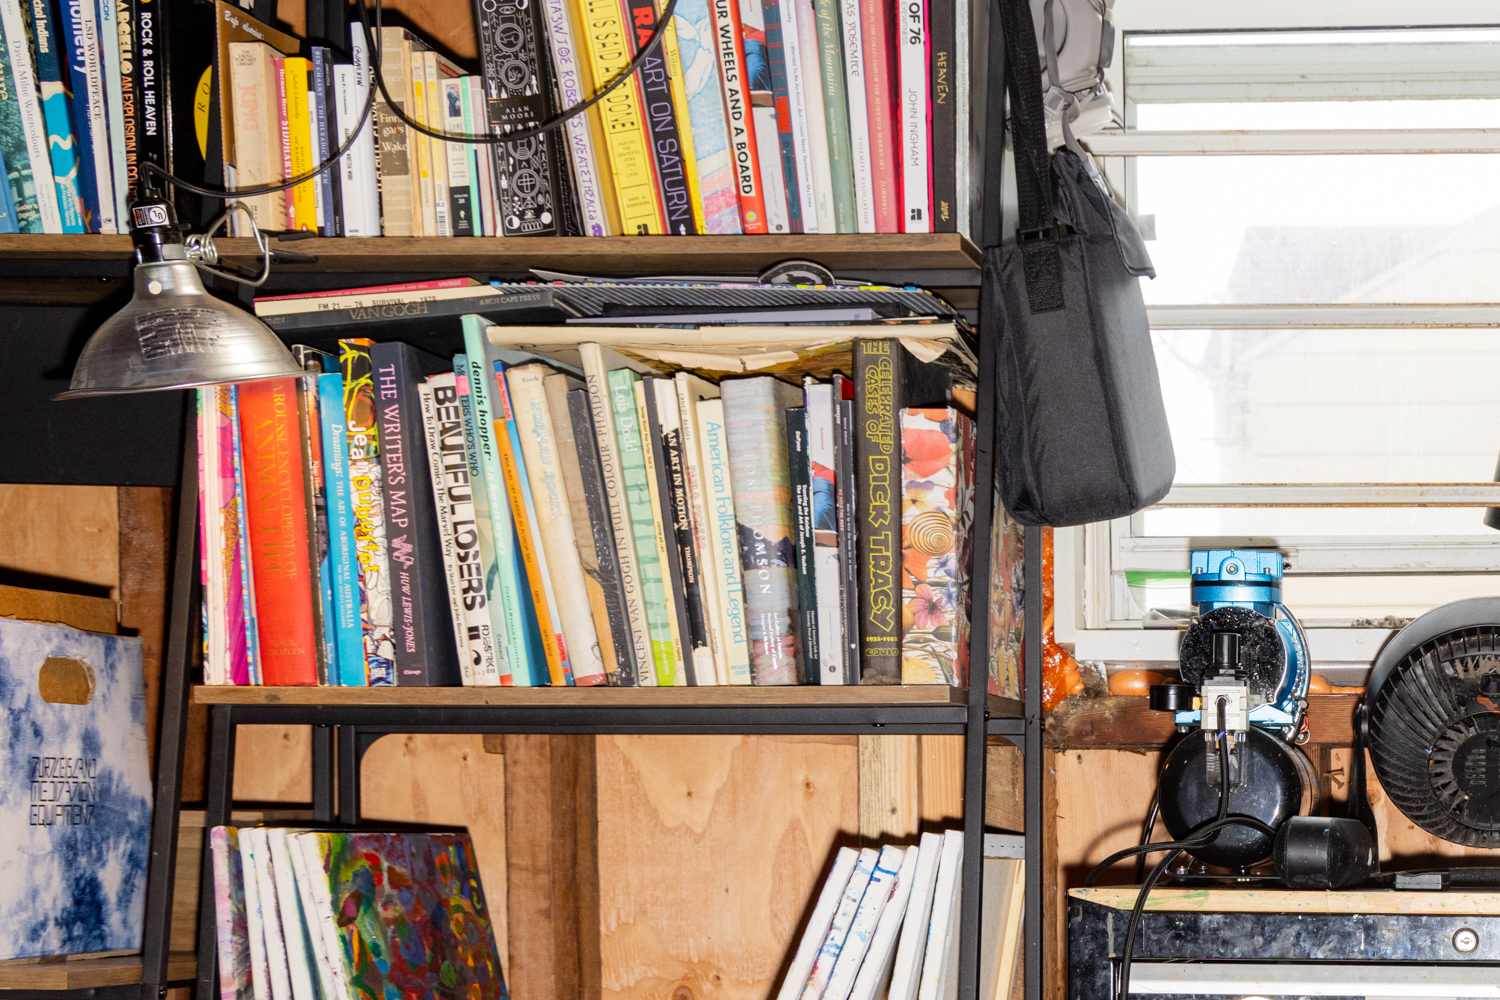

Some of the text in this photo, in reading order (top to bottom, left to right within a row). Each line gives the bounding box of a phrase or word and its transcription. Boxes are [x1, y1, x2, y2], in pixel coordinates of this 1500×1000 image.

[819, 8, 836, 96] of the Mountains
[846, 21, 860, 78] YOSEMITE
[908, 2, 921, 46] OF 76
[84, 19, 102, 120] LSD WORLDPEACE
[140, 12, 157, 136] ROCK & ROLL HEAVEN
[668, 50, 679, 77] Wilson
[720, 24, 738, 83] WHEELS
[936, 51, 948, 104] HEAVEN
[12, 40, 40, 159] David Milne Watercolours
[121, 76, 132, 92] AN
[236, 83, 260, 131] JUNG
[504, 106, 530, 114] ALAN
[728, 88, 743, 121] AND
[122, 94, 136, 149] EXPLOSION
[501, 112, 535, 120] MOORE
[644, 56, 690, 222] ART ON SATURN
[734, 127, 744, 136] A
[908, 88, 920, 167] JOHN INGHAM
[128, 151, 138, 163] IN
[381, 141, 408, 152] Wake
[736, 142, 754, 195] BOARD
[860, 176, 869, 224] ASSOCIATION
[332, 302, 340, 310] 21
[372, 298, 405, 307] SURVIVAL
[350, 302, 429, 320] VAN GOGH
[438, 280, 462, 288] VINTAGE
[860, 340, 890, 354] THE
[614, 384, 638, 454] Lois Dodd
[865, 364, 880, 442] CASES OF
[878, 356, 894, 454] CELEBRATED
[331, 424, 345, 478] Dreamings:
[379, 364, 408, 528] THE WRITER'S MAP
[464, 418, 479, 476] WHO'S WHO
[253, 414, 282, 582] ANIMAL LIFE
[348, 420, 380, 574] Jean Dubuffet
[423, 393, 452, 557] How To Draw Comics The Marvel Way
[434, 386, 486, 612] BEAUTIFUL LOSERS
[667, 430, 689, 530] AN ART IN MOTION
[338, 481, 354, 628] THE ART OF ABORIGINAL AUSTRALIA
[586, 374, 649, 684] VINCENT VAN GOGH IN FULL COLOUR PHAIDON
[706, 421, 747, 644] American Folklore and Legend
[746, 510, 772, 596] THOMSON
[869, 456, 895, 632] DICK TRACY
[683, 546, 694, 584] THOMPSON
[400, 570, 415, 652] HUW LEWIS-JONES
[556, 634, 566, 662] TASCHEN
[865, 648, 899, 656] GOULD
